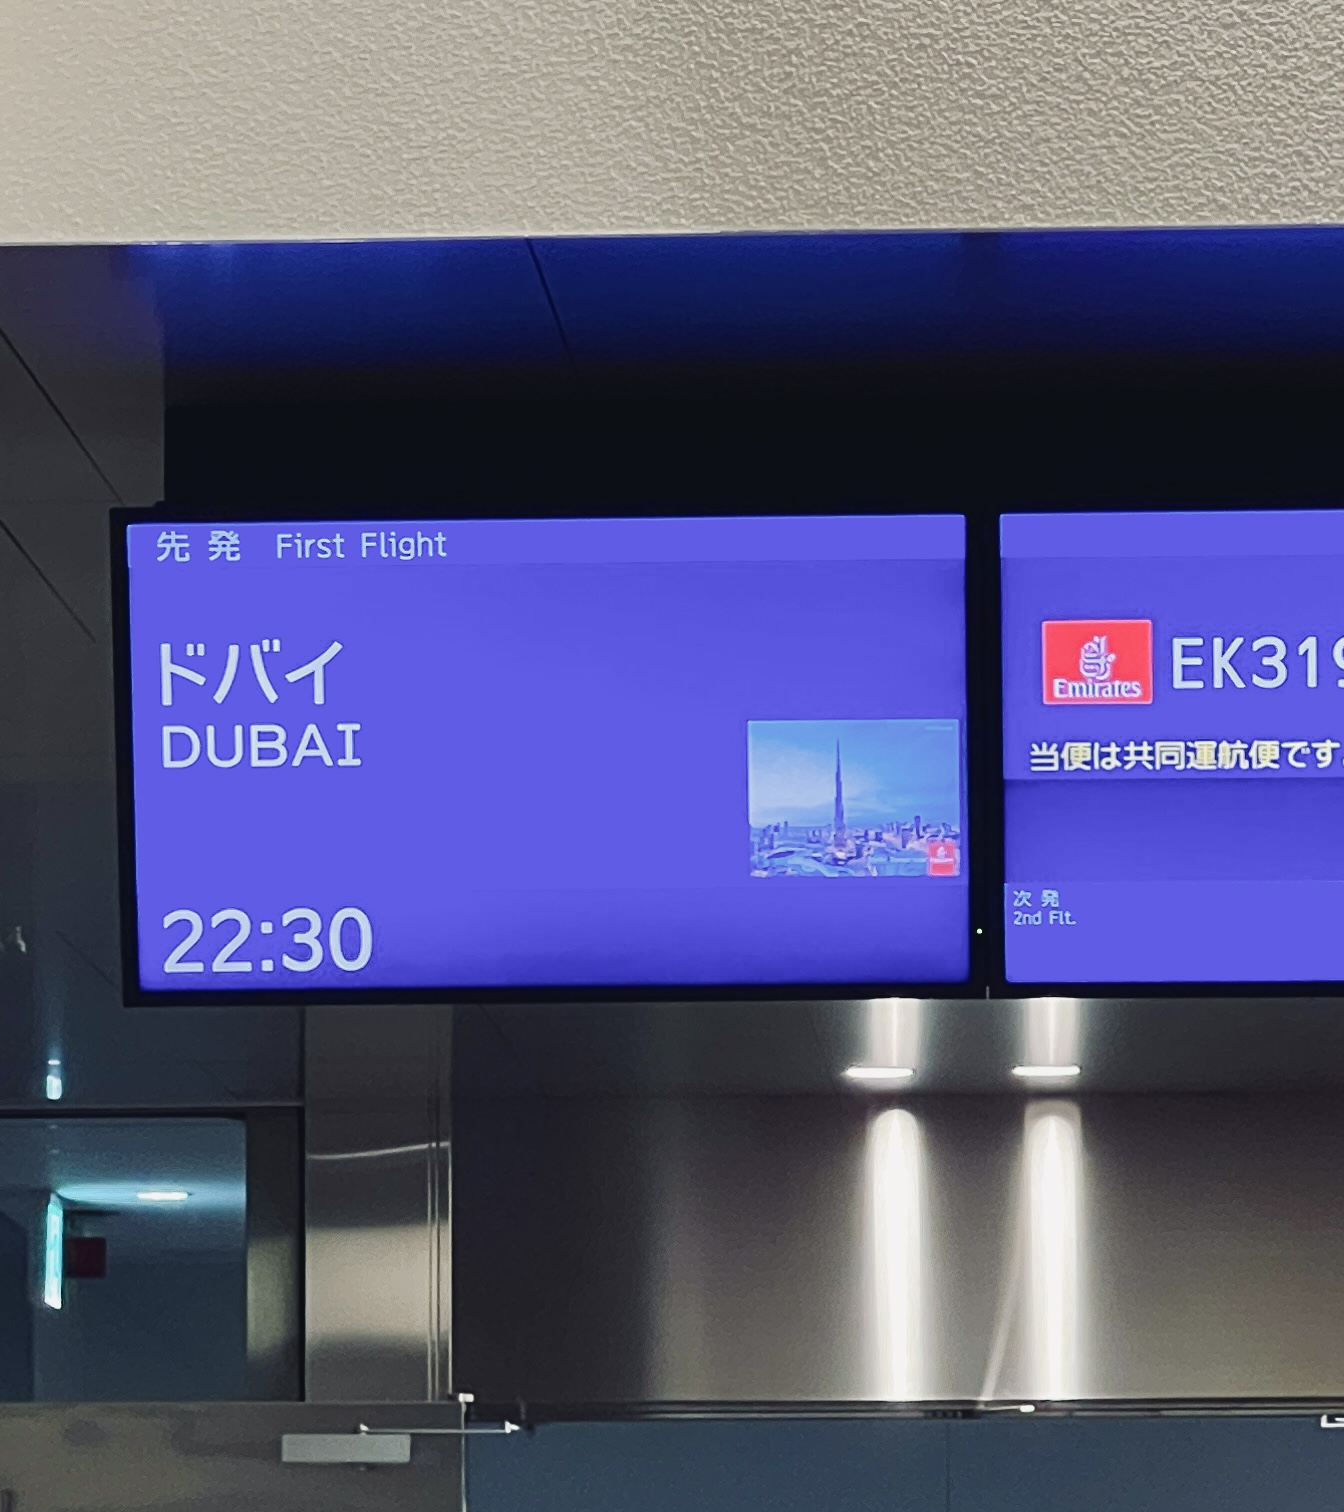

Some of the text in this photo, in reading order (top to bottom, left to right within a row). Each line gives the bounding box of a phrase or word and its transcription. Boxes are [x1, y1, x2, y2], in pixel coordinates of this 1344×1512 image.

[276, 532, 346, 559] First
[361, 530, 448, 561] Flight
[160, 638, 344, 707] ドバイ
[1052, 677, 1143, 698] Emirates
[161, 723, 362, 769] DUBAI
[1013, 910, 1042, 926] 2nd
[162, 907, 373, 974] 22:30
